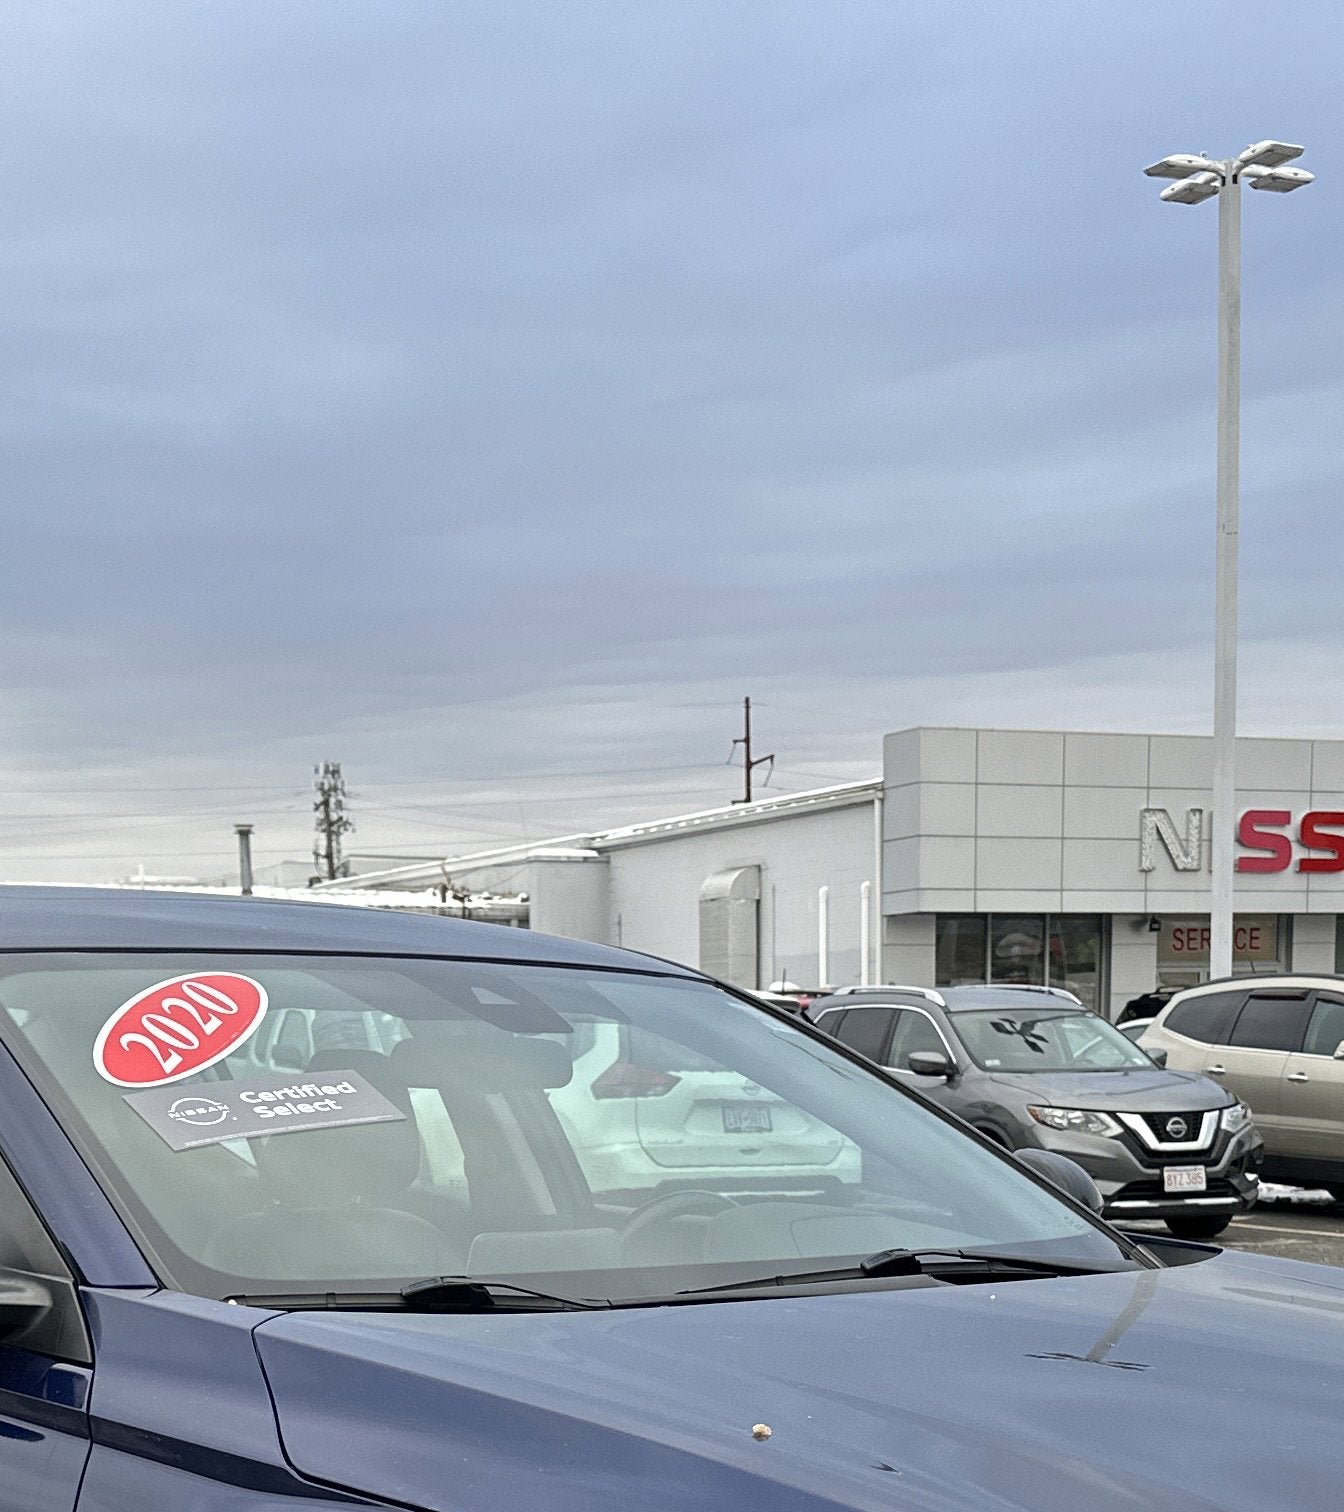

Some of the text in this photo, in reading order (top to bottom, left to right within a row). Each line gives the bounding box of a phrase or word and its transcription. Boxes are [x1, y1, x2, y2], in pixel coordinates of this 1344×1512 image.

[1172, 928, 1261, 951] SERCE
[119, 981, 239, 1075] 2020
[239, 1081, 358, 1104] Certified
[167, 1104, 230, 1119] NISSAN
[253, 1098, 343, 1119] Select
